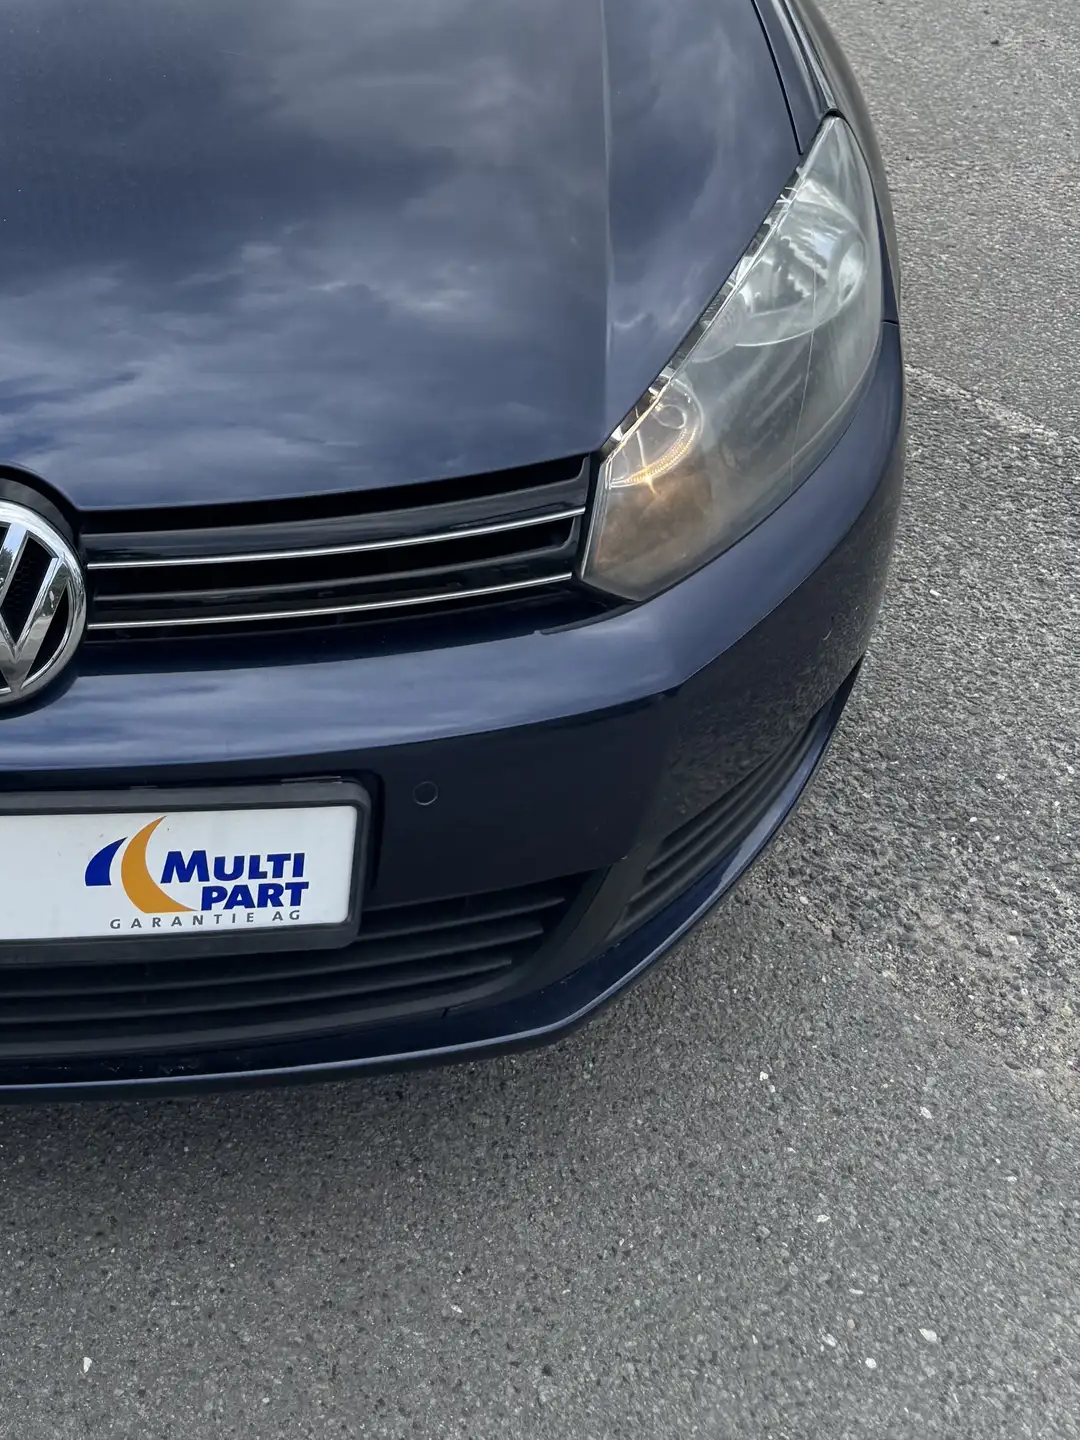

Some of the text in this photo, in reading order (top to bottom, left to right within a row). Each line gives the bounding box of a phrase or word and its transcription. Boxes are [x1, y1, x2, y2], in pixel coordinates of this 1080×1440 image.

[160, 849, 306, 884] MULTI
[200, 881, 309, 911] PART
[110, 909, 301, 930] GARANTIE AG
